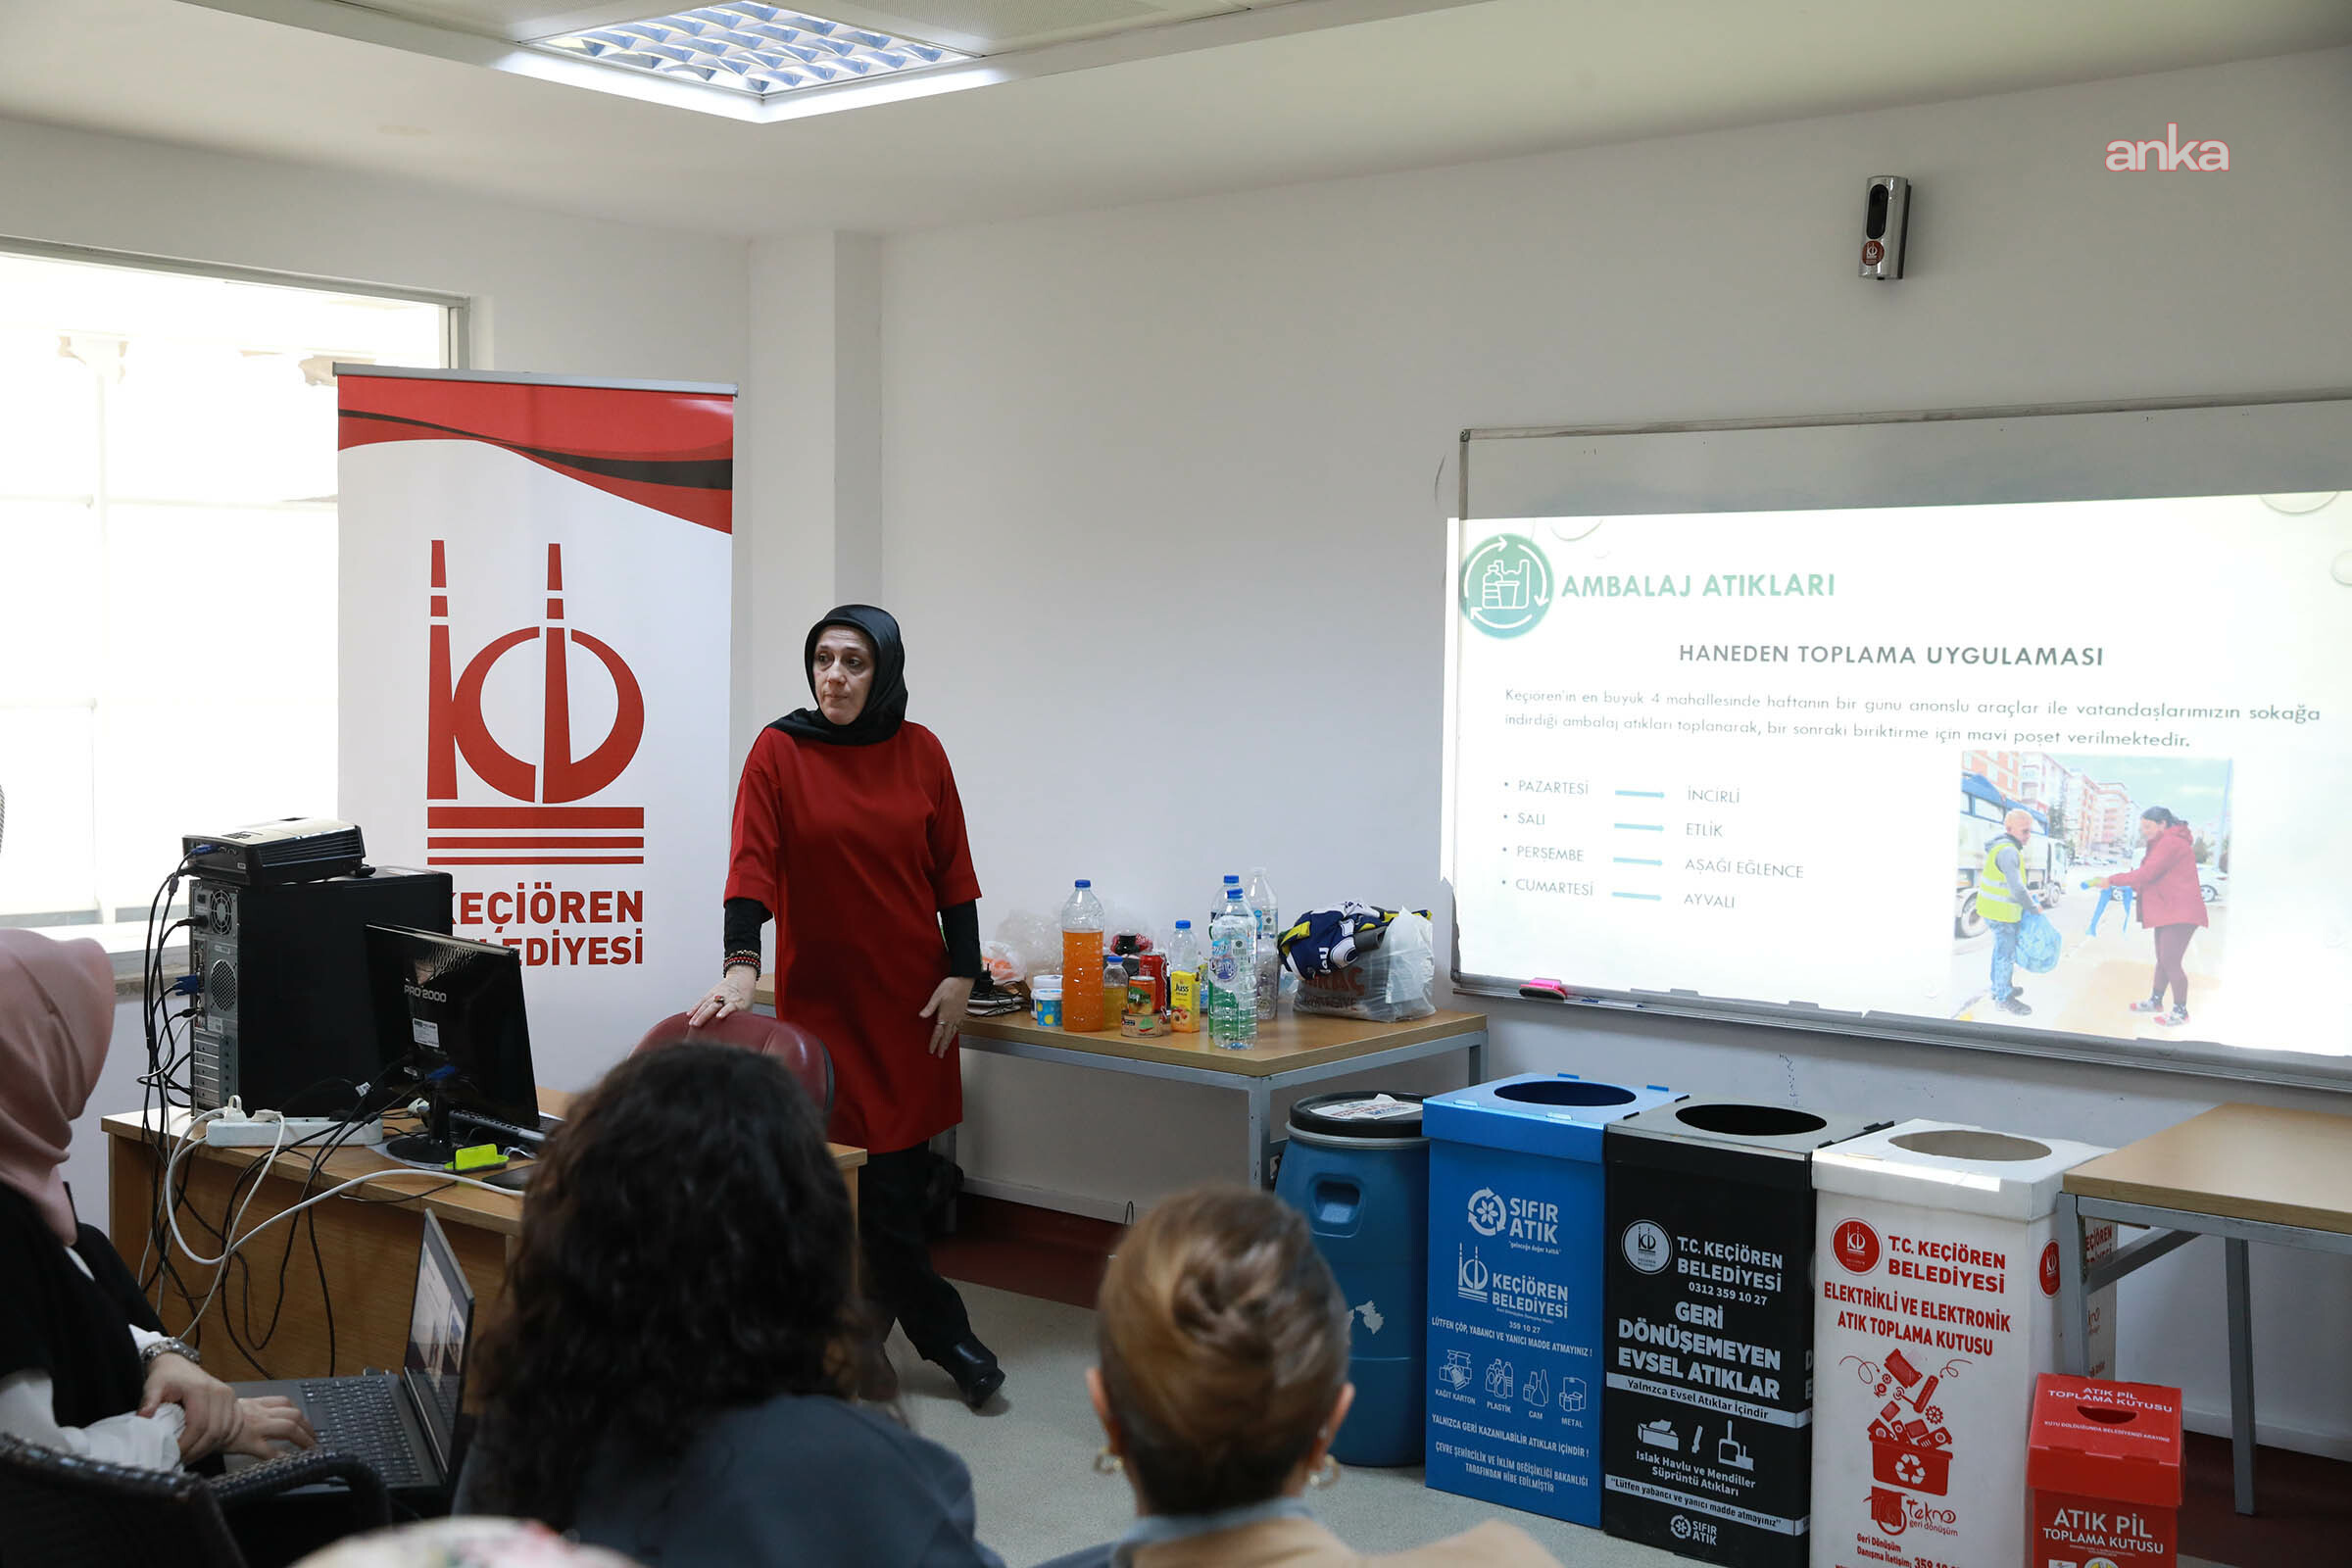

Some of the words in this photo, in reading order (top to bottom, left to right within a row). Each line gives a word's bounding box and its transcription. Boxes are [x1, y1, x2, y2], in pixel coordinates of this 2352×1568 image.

[1561, 574, 1690, 598] AMBALAJ
[1702, 573, 1836, 597] ATIKLARI
[1680, 644, 1788, 662] HANEDEN
[1797, 645, 1916, 664] TOPLAMA
[1927, 646, 2103, 667] UYGULAMASI
[1582, 693, 1598, 704] en
[1651, 692, 1660, 705] 4
[1837, 696, 1858, 710] bir
[1909, 699, 1970, 713] anonslu
[1977, 700, 2038, 719] araçlar
[2047, 701, 2068, 715] ile
[2077, 703, 2240, 721] vatandaşlarımızın
[2249, 704, 2321, 725] sokağa
[1563, 715, 1619, 731] ambalaj
[1677, 718, 1762, 737] toplanarak,
[1853, 723, 1929, 740] biriktirme
[1936, 727, 1961, 744] için
[1967, 728, 2007, 743] mavi
[2014, 730, 2061, 748] poşet
[2068, 730, 2190, 748] verilmektedir.
[1518, 778, 1590, 795] PAZARTESİ
[1688, 785, 1740, 804] İNCİRLİ
[1517, 811, 1545, 825] SALI
[1686, 822, 1723, 837] ETLİK
[1685, 857, 1731, 875] AŞAĞI
[1736, 858, 1804, 879] EĞLENCE
[1515, 878, 1594, 896] CUMARTESİ
[1684, 893, 1736, 908] AYVALI
[452, 882, 643, 933] EÇİÖREN
[404, 984, 421, 997] PRO
[422, 989, 447, 1003] 2000
[1509, 1197, 1559, 1224] SIFIR
[1509, 1217, 1558, 1245] ATIK
[2085, 1225, 2113, 1250] EÇİÖREN
[1677, 1236, 1701, 1255] T.C.
[1704, 1241, 1784, 1270] KEÇİÖREN
[1887, 1235, 1915, 1254] T.C.
[1918, 1240, 2006, 1270] KEÇİÖREN
[1493, 1272, 1568, 1301] KEÇİÖREN
[1677, 1257, 1783, 1293] BELEDİYESİ
[1887, 1258, 2005, 1295] BELEDİYESİ
[1492, 1291, 1568, 1319] BELEDİYESİ
[1688, 1281, 1715, 1296] 0312
[1716, 1287, 1737, 1299] 359
[1739, 1291, 1752, 1303] 10
[1753, 1294, 1768, 1306] 27
[1824, 1281, 1898, 1312] ELEKTRİKLİ
[1901, 1298, 1918, 1315] VE
[1921, 1300, 2011, 1333] ELEKTRONİK
[1675, 1300, 1724, 1330] GERİ
[1432, 1316, 1454, 1330] LÜTFEN
[1469, 1325, 1495, 1340] YABANCI
[1495, 1331, 1504, 1342] VE
[1505, 1332, 1527, 1346] YANICI
[1528, 1337, 1550, 1350] MADDE
[1551, 1340, 1588, 1356] ATMAYINIZ
[1618, 1316, 1781, 1371] DÖNÜŞEMEYEN
[1837, 1310, 1867, 1332] ATIK
[1869, 1316, 1933, 1347] TOPLAMA
[1936, 1330, 1993, 1356] KUTUSU
[1618, 1346, 1684, 1379] EVSEL
[1687, 1360, 1781, 1400] ATIKLAR
[1452, 1392, 1476, 1405] KARTON
[1486, 1400, 1512, 1414] PLASTİK
[1627, 1379, 1668, 1396] Yalnızca
[1670, 1388, 1696, 1403] Evsel
[1697, 1394, 1733, 1411] Atıklar
[1734, 1400, 1769, 1420] İçindir
[2048, 1390, 2113, 1404] TOPLAMA
[2116, 1398, 2173, 1413] KUTUSU
[2082, 1387, 2114, 1397] ATIK
[2117, 1389, 2138, 1400] PİL
[1528, 1410, 1544, 1420] CAM
[1561, 1417, 1584, 1429] METAL
[1432, 1413, 1461, 1430] YALNIZCA
[1462, 1420, 1477, 1434] GERİ
[1478, 1425, 1527, 1446] KAZANILABİLİR
[1528, 1436, 1557, 1452] ATIKLAR
[1558, 1442, 1585, 1458] İÇİNDİR
[1436, 1441, 1453, 1456] ÇEVRE
[1488, 1453, 1495, 1465] VE
[1496, 1455, 1515, 1470] İKLİM
[1465, 1462, 1502, 1481] TARAFINDAN
[1636, 1449, 1660, 1465] Islak
[1662, 1456, 1691, 1472] Havlu
[1692, 1464, 1705, 1475] ve
[1706, 1466, 1756, 1490] Mendiller
[1651, 1466, 1699, 1488] Süprüntü
[1700, 1478, 1740, 1497] Atıkları
[1673, 1494, 1683, 1503] ve
[1709, 1501, 1736, 1517] madde
[1691, 1519, 1718, 1535] SIFIR
[2054, 1507, 2107, 1533] ATIK
[2116, 1512, 2153, 1539] PİL
[1691, 1530, 1718, 1545] ATIK
[1871, 1536, 1902, 1553] Dönüşüm
[2042, 1527, 2106, 1546] TOPLAMA
[2109, 1536, 2164, 1555] KUTUSU
